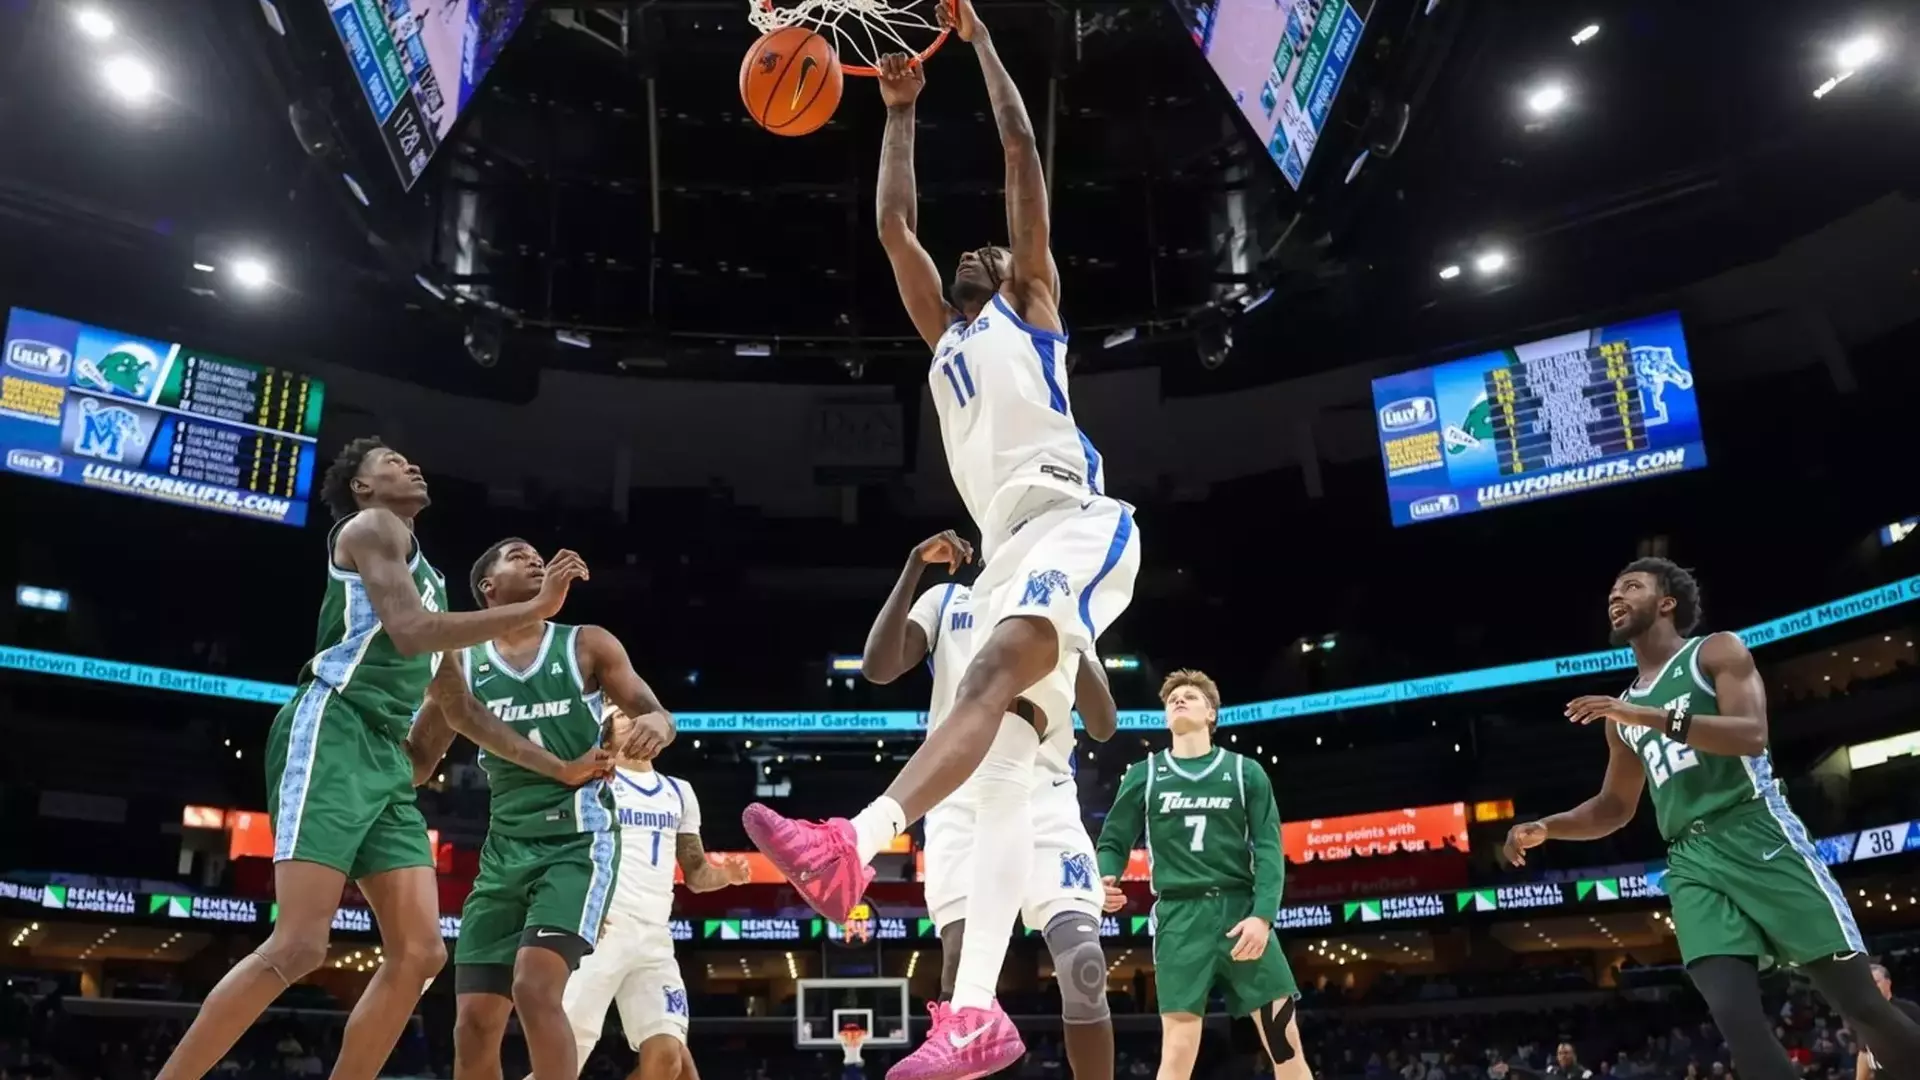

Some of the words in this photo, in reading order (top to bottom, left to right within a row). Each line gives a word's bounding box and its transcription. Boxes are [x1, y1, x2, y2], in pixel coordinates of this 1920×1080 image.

[942, 352, 975, 408] 11
[1477, 448, 1685, 502] LILLYFORKLIFTS.COM
[82, 463, 290, 517] LILLYFORKLIFTS.COM
[1780, 613, 1813, 635] and
[1817, 583, 1904, 624] Memorial
[0, 650, 76, 673] antown
[82, 660, 131, 681] Road
[137, 671, 153, 683] in
[160, 671, 228, 694] Bartlett
[707, 714, 737, 729] and
[742, 713, 816, 729] Memorial
[821, 713, 889, 729] Gardens
[1643, 738, 1700, 789] 22
[1158, 791, 1234, 814] TULANE
[1184, 815, 1207, 852] 7
[1307, 831, 1343, 846] Score
[1345, 826, 1385, 843] points
[1388, 822, 1416, 836] with
[1869, 829, 1895, 854] 38
[651, 831, 661, 867] 1
[67, 886, 135, 904] RENEWAL
[1497, 883, 1562, 900] RENEWAL
[76, 900, 135, 914] ANDERSEN
[193, 896, 257, 913] RENEWAL
[1382, 894, 1444, 911] RENEWAL
[1508, 895, 1563, 909] ANDERSEN
[201, 909, 257, 922] ANDERSEN
[1392, 904, 1445, 919] ANDERSEN
[742, 919, 799, 931] RENEWAL
[1282, 916, 1332, 929] ANDERSEN
[750, 930, 799, 940] ANDERSEN
